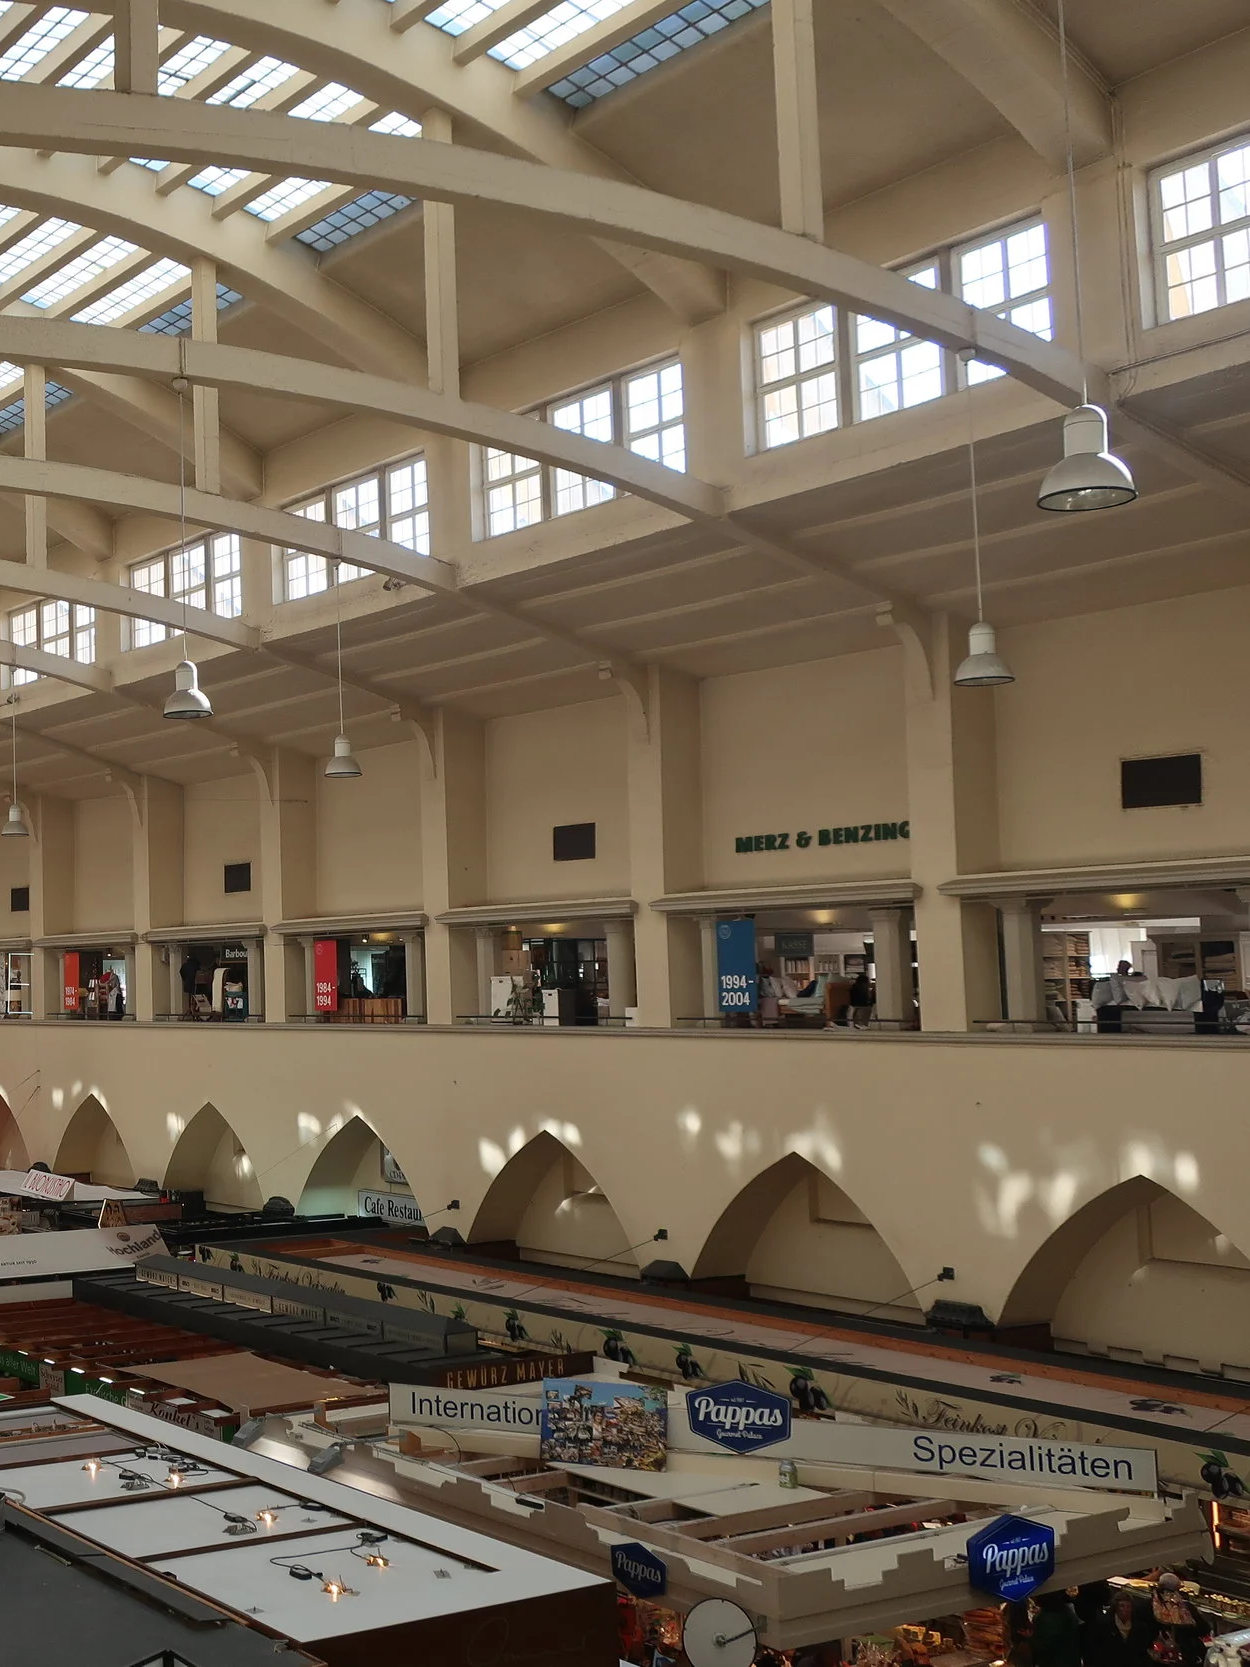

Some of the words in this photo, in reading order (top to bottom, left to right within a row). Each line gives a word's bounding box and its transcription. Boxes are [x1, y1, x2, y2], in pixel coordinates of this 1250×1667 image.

[735, 832, 790, 854] MERZ
[795, 830, 813, 848] &
[225, 949, 247, 958] Barbou
[64, 997, 76, 1006] 1984
[316, 994, 332, 1007] 1994
[721, 991, 751, 1007] 2004
[364, 1196, 384, 1215] Cafe
[105, 1229, 161, 1256] Hochland
[20, 1361, 36, 1377] Welt
[446, 1364, 508, 1389] GEWÜRZ
[516, 1358, 565, 1379] MAYER
[694, 1396, 783, 1430] Pappas
[912, 1435, 1134, 1481] Spezialitäten
[615, 1551, 662, 1583] Pappas
[982, 1541, 1049, 1578] Pappas
